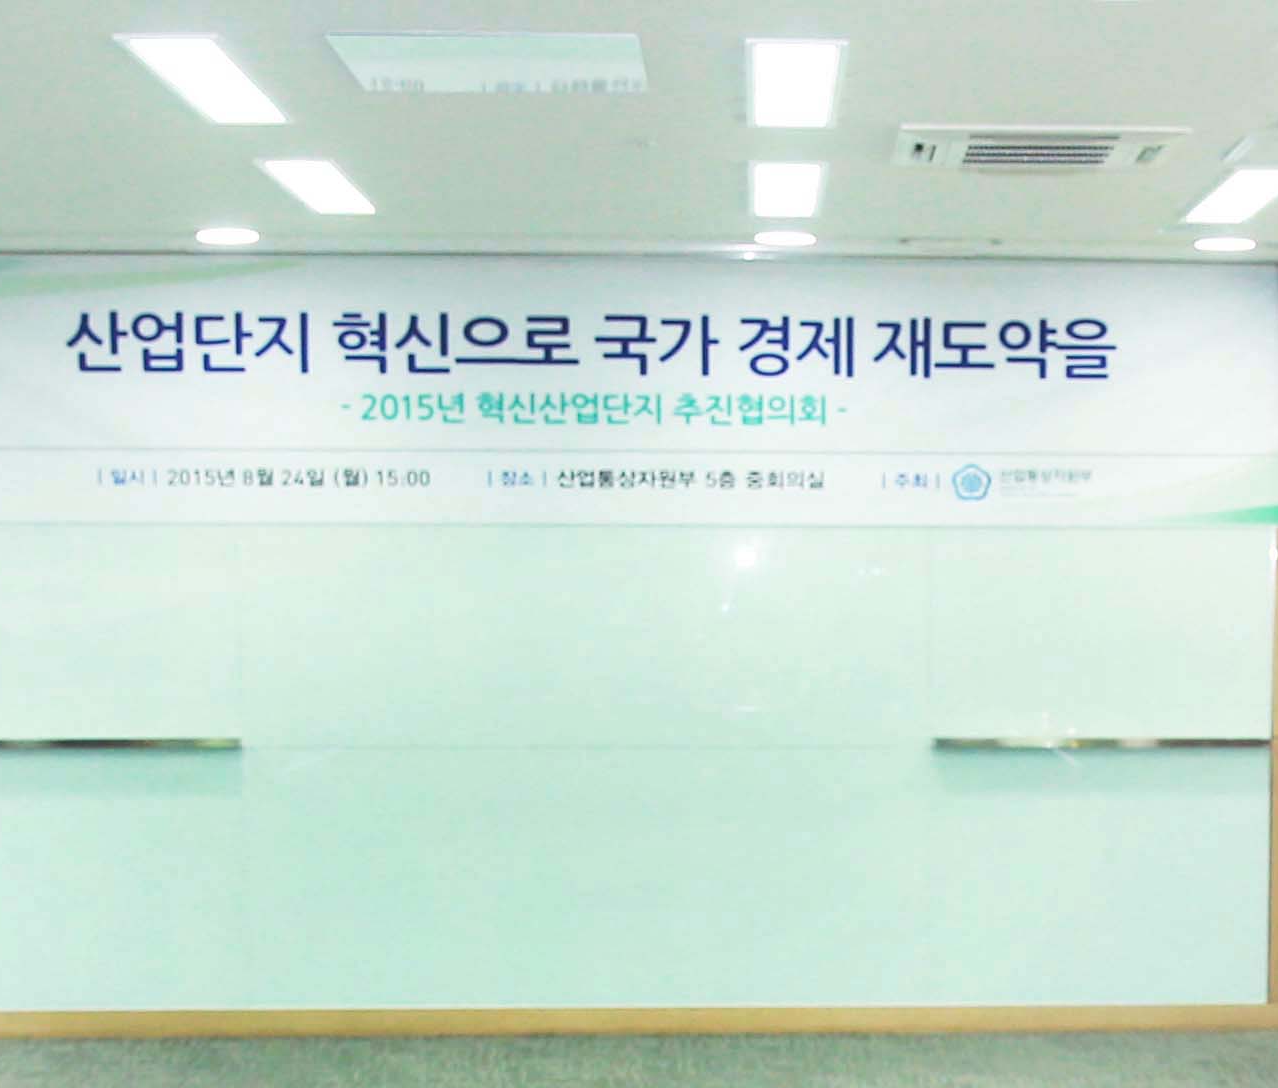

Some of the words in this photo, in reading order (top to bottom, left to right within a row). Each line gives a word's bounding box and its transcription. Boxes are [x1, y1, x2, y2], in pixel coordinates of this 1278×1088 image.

[65, 310, 310, 375] 산업단지
[332, 311, 581, 375] 혁신으로
[593, 313, 721, 377] 국가
[738, 315, 855, 379] 경제
[872, 316, 1118, 380] 재도약을
[360, 391, 465, 425] 2015년
[476, 391, 663, 426] 혁신산업단지
[673, 392, 827, 427] 추진협의회
[167, 467, 236, 488] 2015년
[242, 466, 275, 488] 8월
[281, 467, 325, 489] 24일
[333, 466, 369, 489] (월)
[375, 468, 432, 488] 15:00
[499, 468, 535, 488] 장소
[556, 467, 696, 490] 산업통상자원부
[704, 468, 737, 490] 5층
[745, 469, 825, 491] 중회의실
